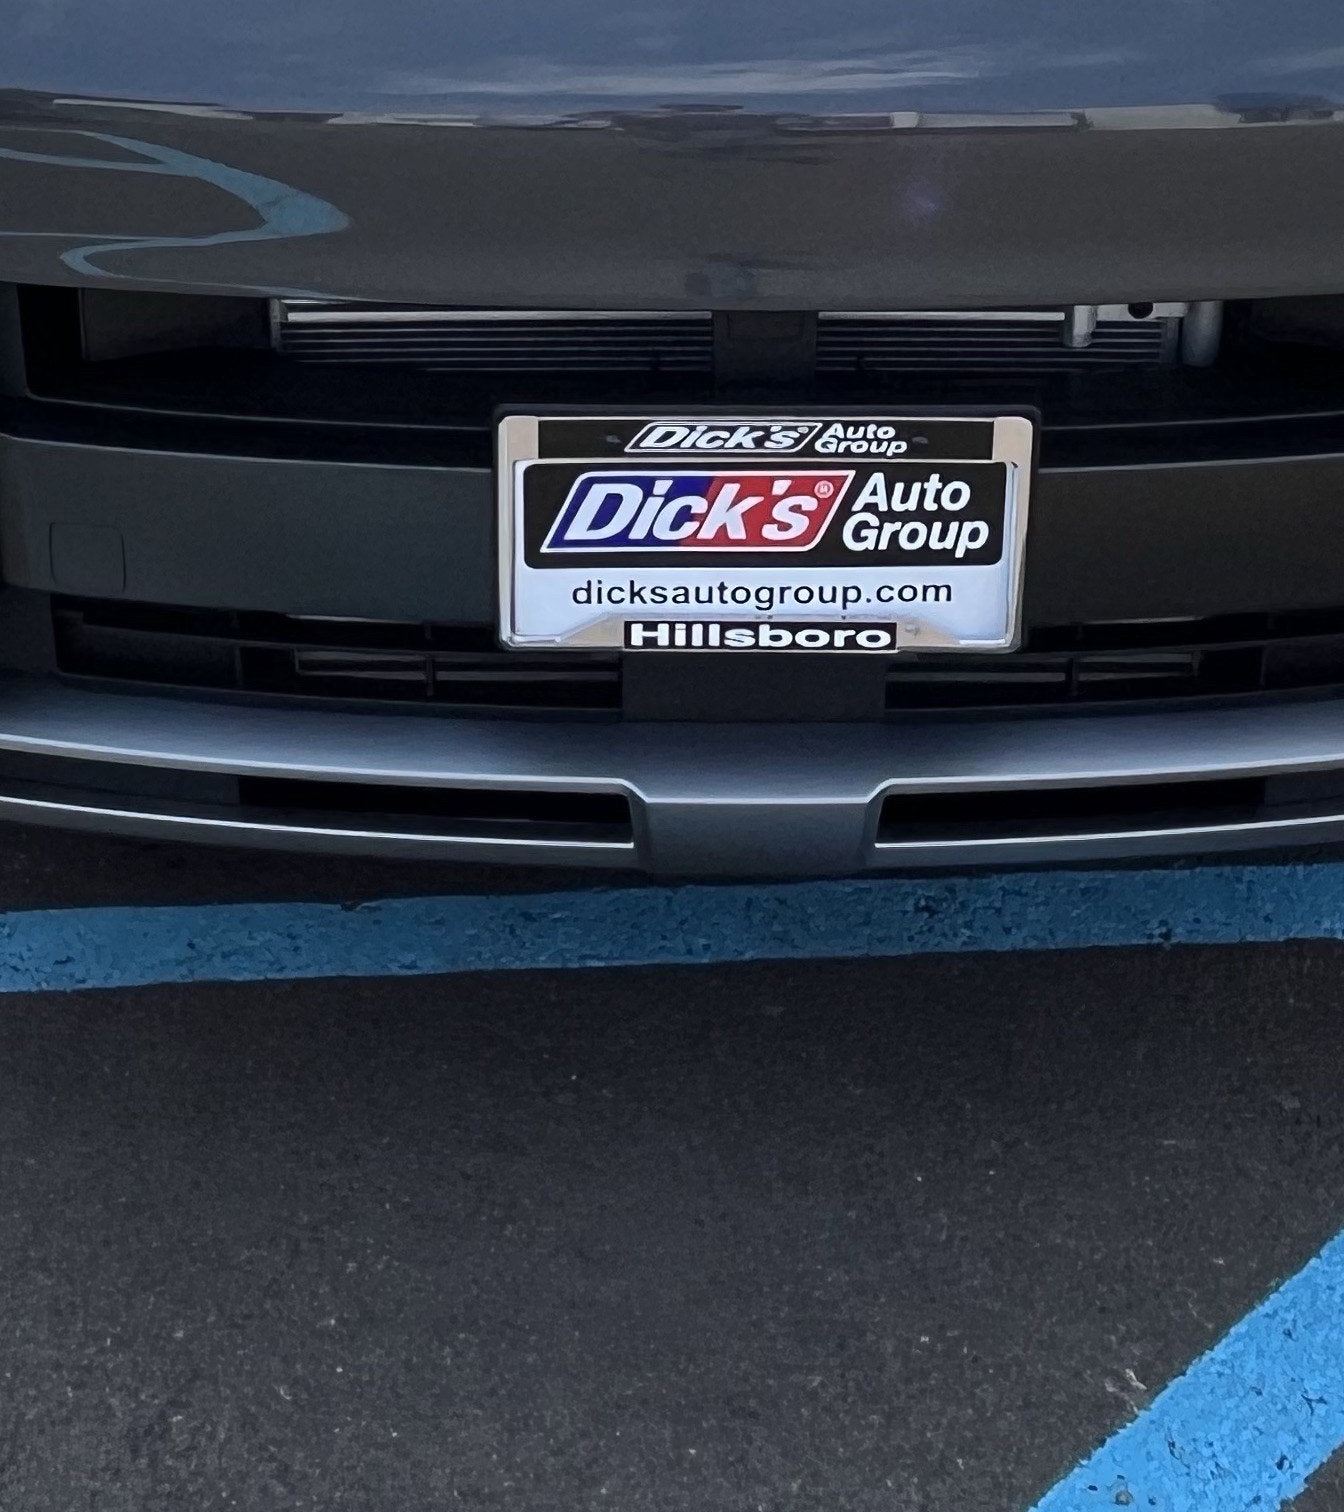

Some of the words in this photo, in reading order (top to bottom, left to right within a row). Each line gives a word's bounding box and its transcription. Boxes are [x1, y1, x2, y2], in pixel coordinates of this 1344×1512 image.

[639, 425, 800, 449] Dick's
[820, 422, 896, 439] Auto
[814, 439, 908, 456] Group
[564, 480, 818, 540] Dick's
[851, 472, 971, 512] Auto
[842, 513, 989, 557] Group
[572, 580, 953, 610] dicksautogroup.com
[630, 622, 892, 648] Hillsboro
